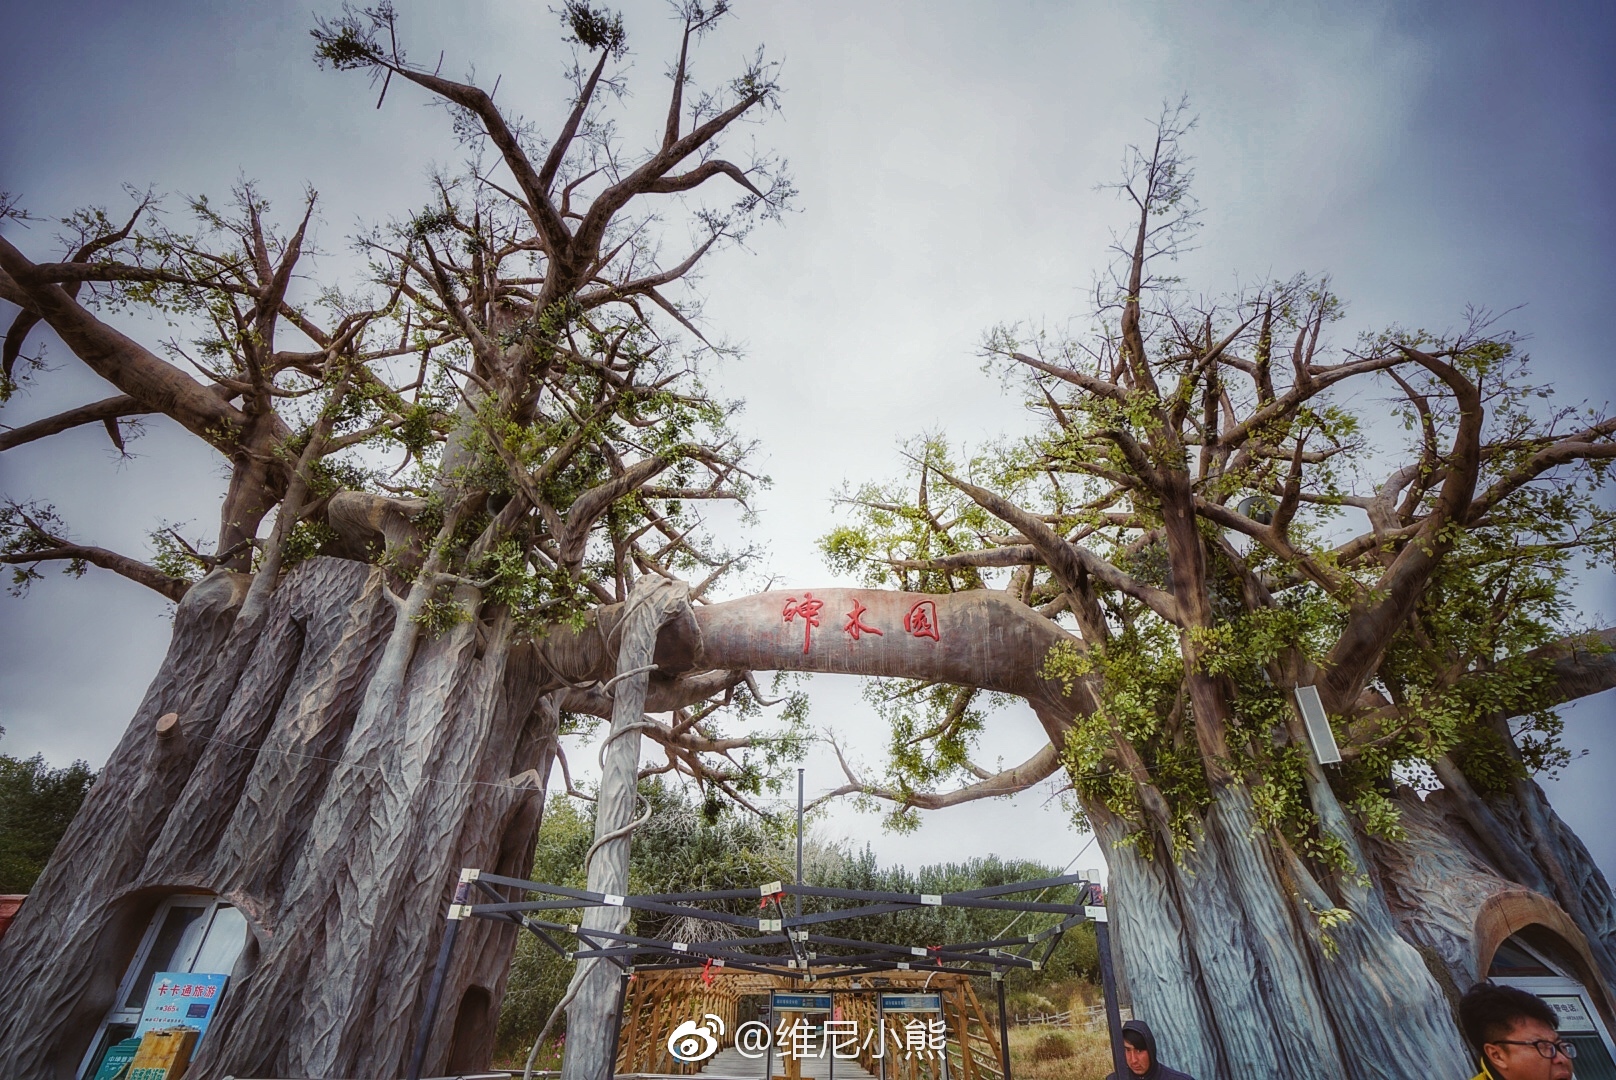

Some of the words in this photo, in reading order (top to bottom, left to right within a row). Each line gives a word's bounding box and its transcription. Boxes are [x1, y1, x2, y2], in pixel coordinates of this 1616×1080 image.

[157, 984, 217, 998] 卡卡通旅游
